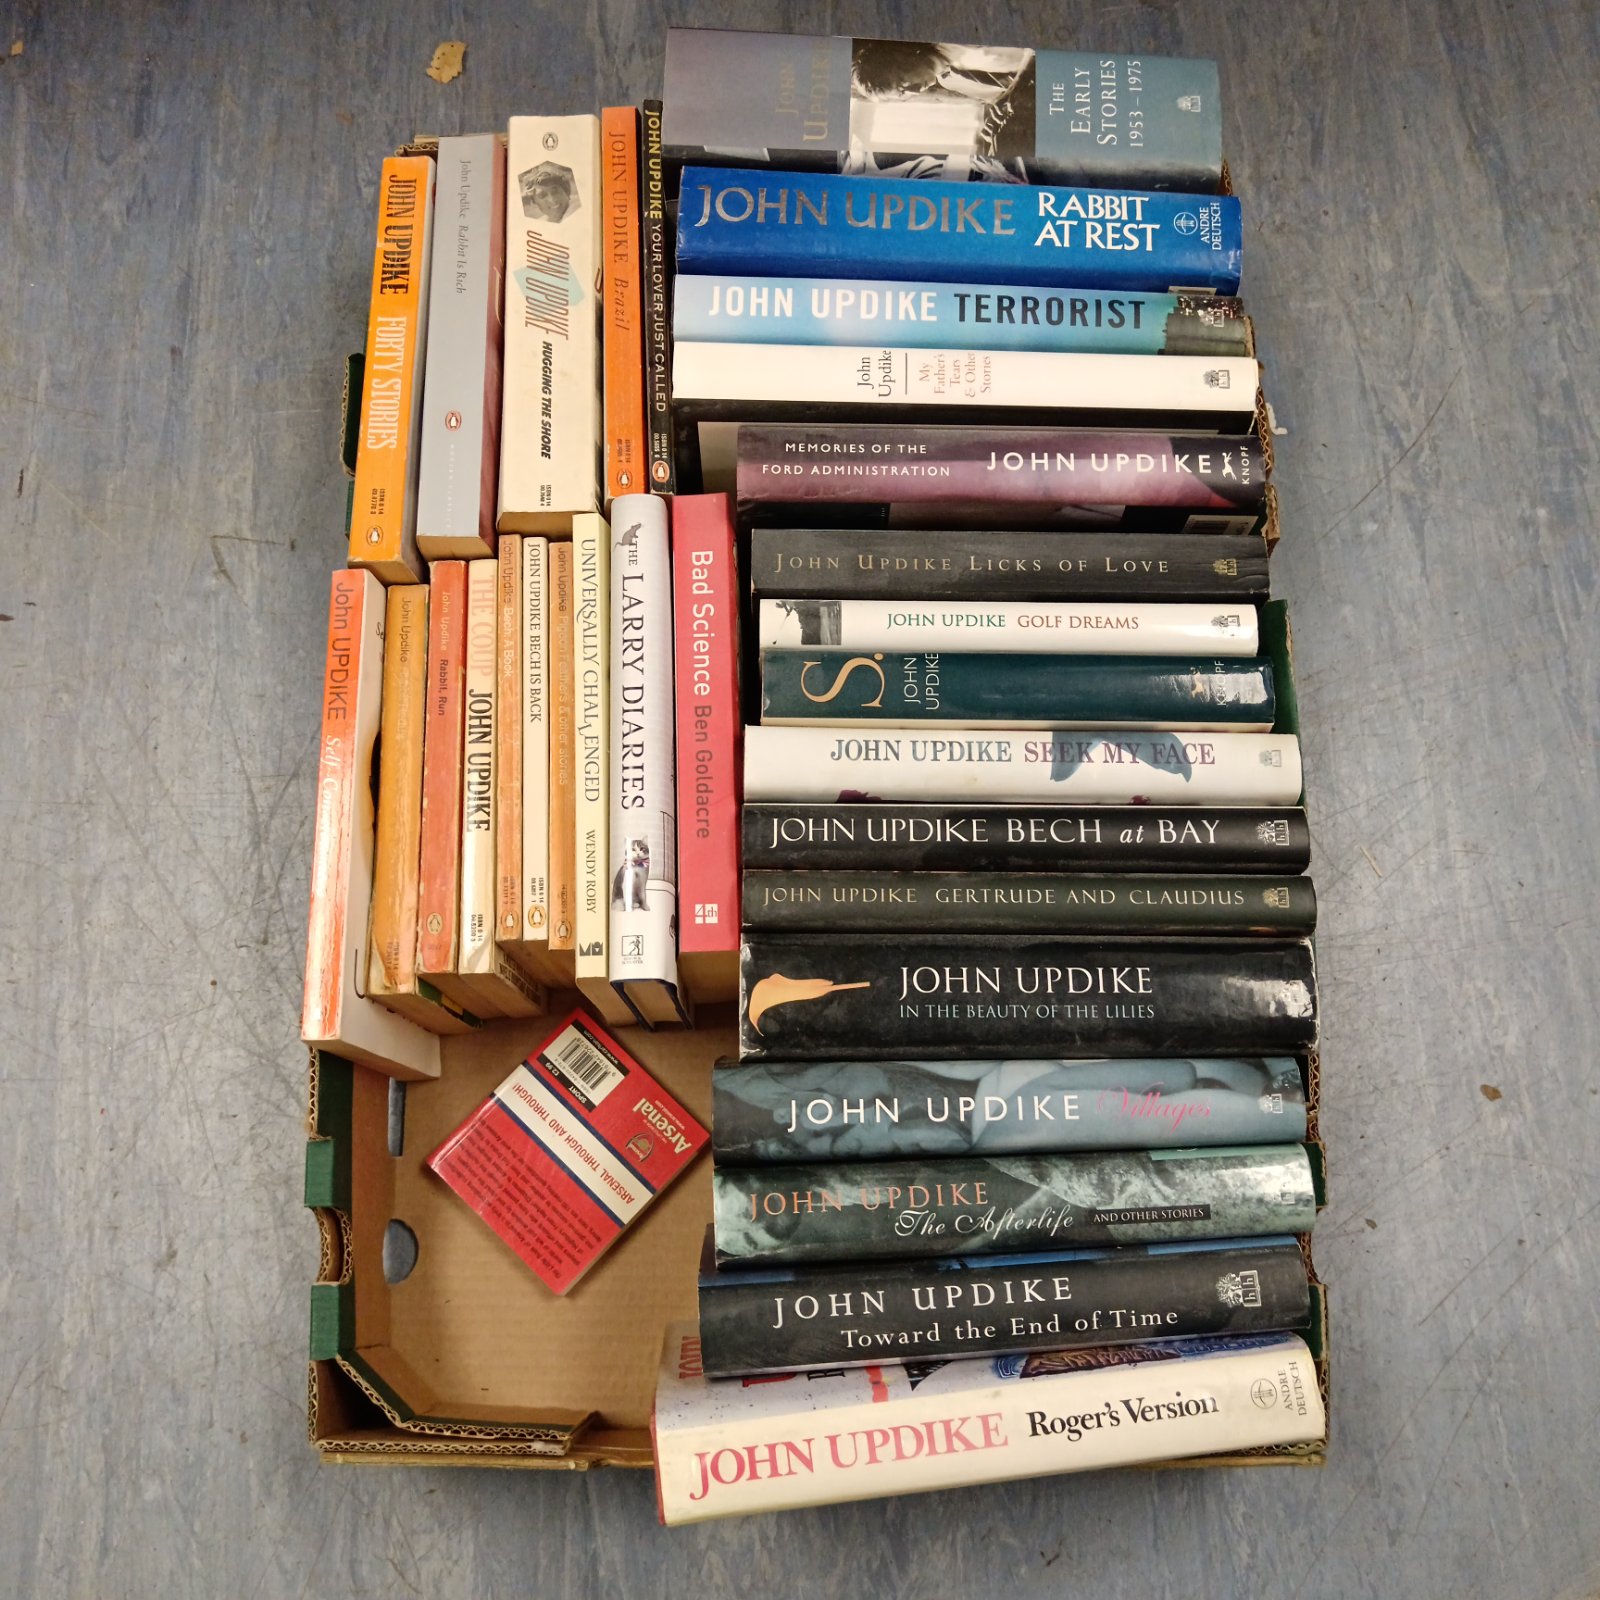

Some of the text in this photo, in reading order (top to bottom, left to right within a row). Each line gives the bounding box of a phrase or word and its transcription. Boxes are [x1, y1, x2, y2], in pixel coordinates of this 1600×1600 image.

[1049, 82, 1065, 116] THE
[1070, 67, 1091, 134] EARLY
[1096, 59, 1118, 146] STORIES
[694, 185, 1016, 236] JOHN UPDIKE
[1038, 191, 1149, 221] RABBIT
[1200, 207, 1209, 243] ANDRE
[1212, 202, 1220, 250] DEUTSCH
[456, 160, 471, 294] John Updike Rabbit Is Rich
[609, 132, 630, 331] JOHN UPDIKE Brazil
[1034, 220, 1160, 251] AT REST
[645, 109, 666, 412] JOHN UPDIKE YOUR LOVER JUST CALLED
[367, 174, 417, 449] JOHN UPDIKE FORTY STORIES
[709, 286, 1145, 329] JOHN UPDIKE TERRORIST
[525, 230, 570, 460] JOHN UPDIKE HUGGING THE SHORE
[857, 357, 874, 389] John
[878, 350, 895, 397] Updike
[919, 362, 933, 382] My
[950, 359, 960, 387] Tears
[965, 353, 976, 383] Other
[981, 356, 991, 393] Stories
[785, 443, 927, 454] MEMORIES OF THE
[987, 452, 1212, 474] JOHN UPDIKE
[1241, 446, 1250, 485] KNOPF
[762, 464, 950, 477] FORD ADMINISTRATION
[557, 547, 566, 573] John
[774, 553, 1169, 573] JOHN UPDIKE LICKS OF LOVE
[442, 591, 451, 613] John
[503, 542, 514, 678] John Updike A Book
[557, 575, 569, 612] Updike
[400, 596, 412, 663] John Updike
[440, 616, 450, 651] Updike
[528, 543, 542, 723] JOHN UPDIKE BECH IS BACK
[886, 613, 1139, 630] JOHN UPDIKE GOLF DREAMS
[327, 582, 353, 721] John UPDIKE
[621, 541, 645, 810] THE LARRY DIARIES
[691, 550, 715, 838] Bad Science Ben Goldacre
[904, 657, 921, 704] JOHN
[925, 653, 940, 710] UPDIKE
[438, 696, 448, 716] Run
[466, 575, 496, 833] THE COUP JOHN UPDIKE
[576, 538, 600, 913] UNIVERSALLY CHALLENGED WENDY ROBY
[830, 739, 1216, 765] JOHN UPDIKE SEEK MY FACE
[770, 817, 1220, 848] JOHN UPDIKE BECH at BAY
[764, 887, 1245, 906] JOHN UPDIKE GERTRUDE AND CLAUDIUS
[899, 966, 1153, 1000] JOHN UPDIKE
[900, 1004, 1155, 1019] IN THE BEAUTY OF THE LILIES
[568, 1085, 588, 1104] SPORT
[787, 1081, 1211, 1133] JOHN UPDIKE Villages
[511, 1082, 636, 1206] ARSENAL THROUGH AND THROUGH!
[631, 1097, 693, 1157] Arsenal
[750, 1182, 988, 1222] JOHN UPDIKE
[894, 1204, 1204, 1240] The Afterlife AND OTHER STORIES
[772, 1278, 1072, 1329] JOHN UPDIKE
[841, 1309, 1179, 1348] Toward the End of Time
[1278, 1370, 1294, 1411] ANDRE
[1289, 1361, 1307, 1416] DEUTSCH
[689, 1391, 1219, 1501] JOHN UPDIKE Roger's Version
